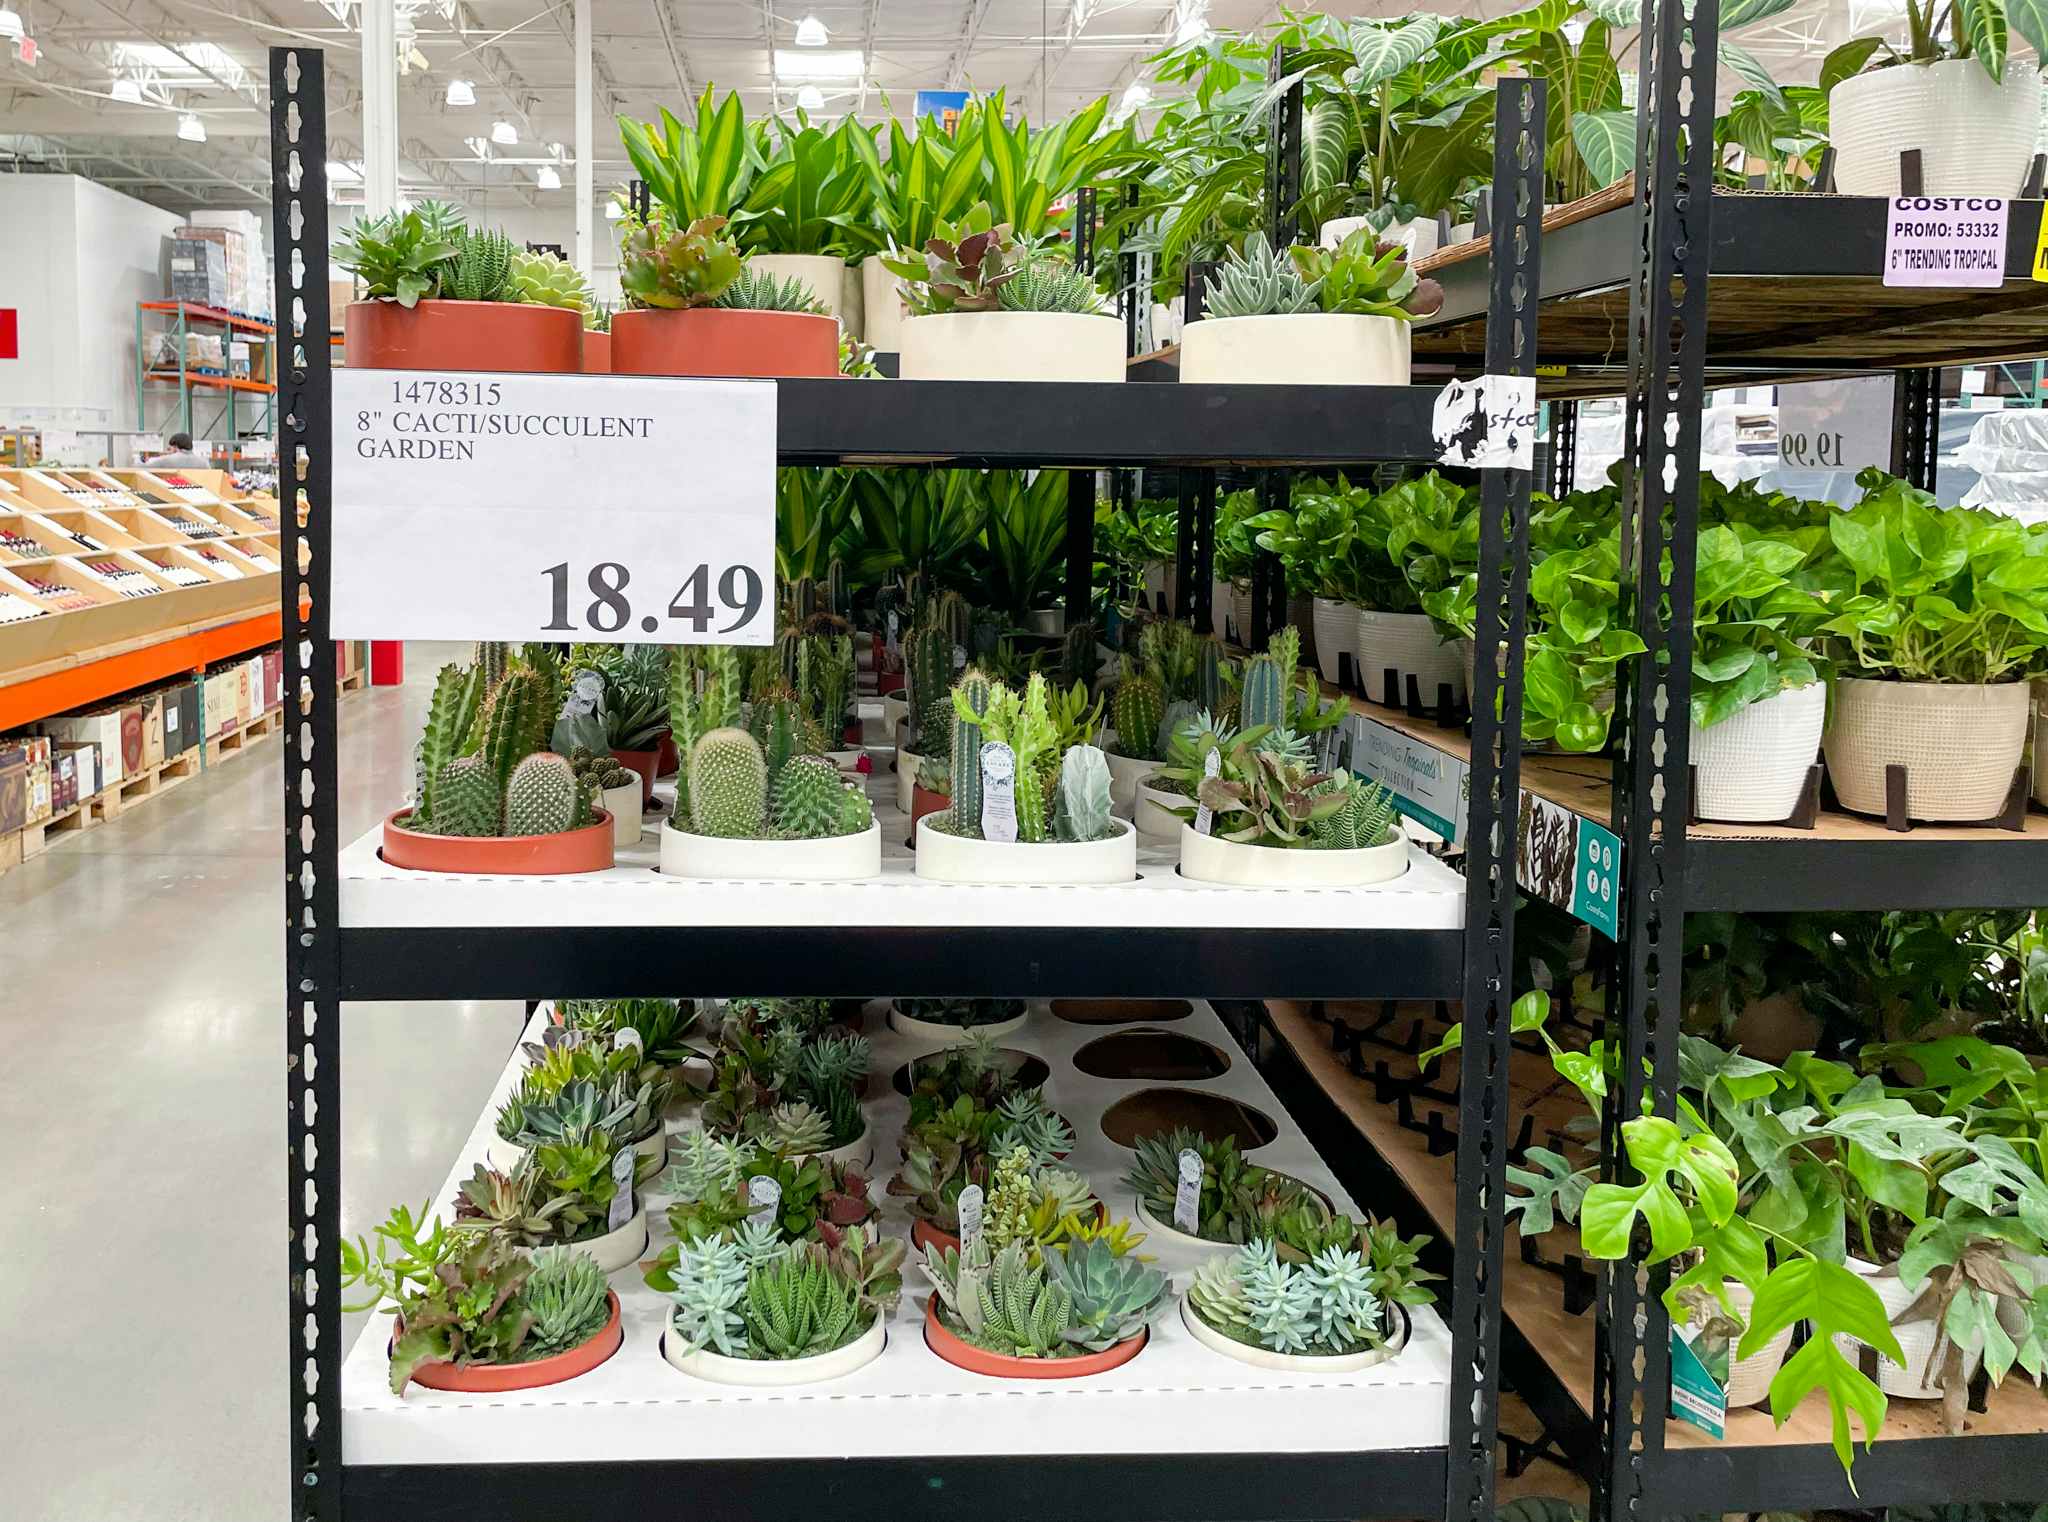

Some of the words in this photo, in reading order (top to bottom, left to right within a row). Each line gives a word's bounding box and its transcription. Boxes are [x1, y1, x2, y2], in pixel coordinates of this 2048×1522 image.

[1895, 197, 2002, 211] COSTCO
[1894, 222, 1952, 237] PROMO:
[1956, 222, 1999, 238] 53332
[1891, 249, 1902, 269] 6"
[1904, 249, 1950, 269] TRENDING
[1953, 249, 1998, 270] TROPICAL
[392, 381, 502, 407] 1478315
[357, 410, 383, 432] 8"
[393, 412, 654, 438] CACTI/SUCCULENT
[357, 438, 475, 461] GARDEN
[540, 561, 764, 635] 18.49
